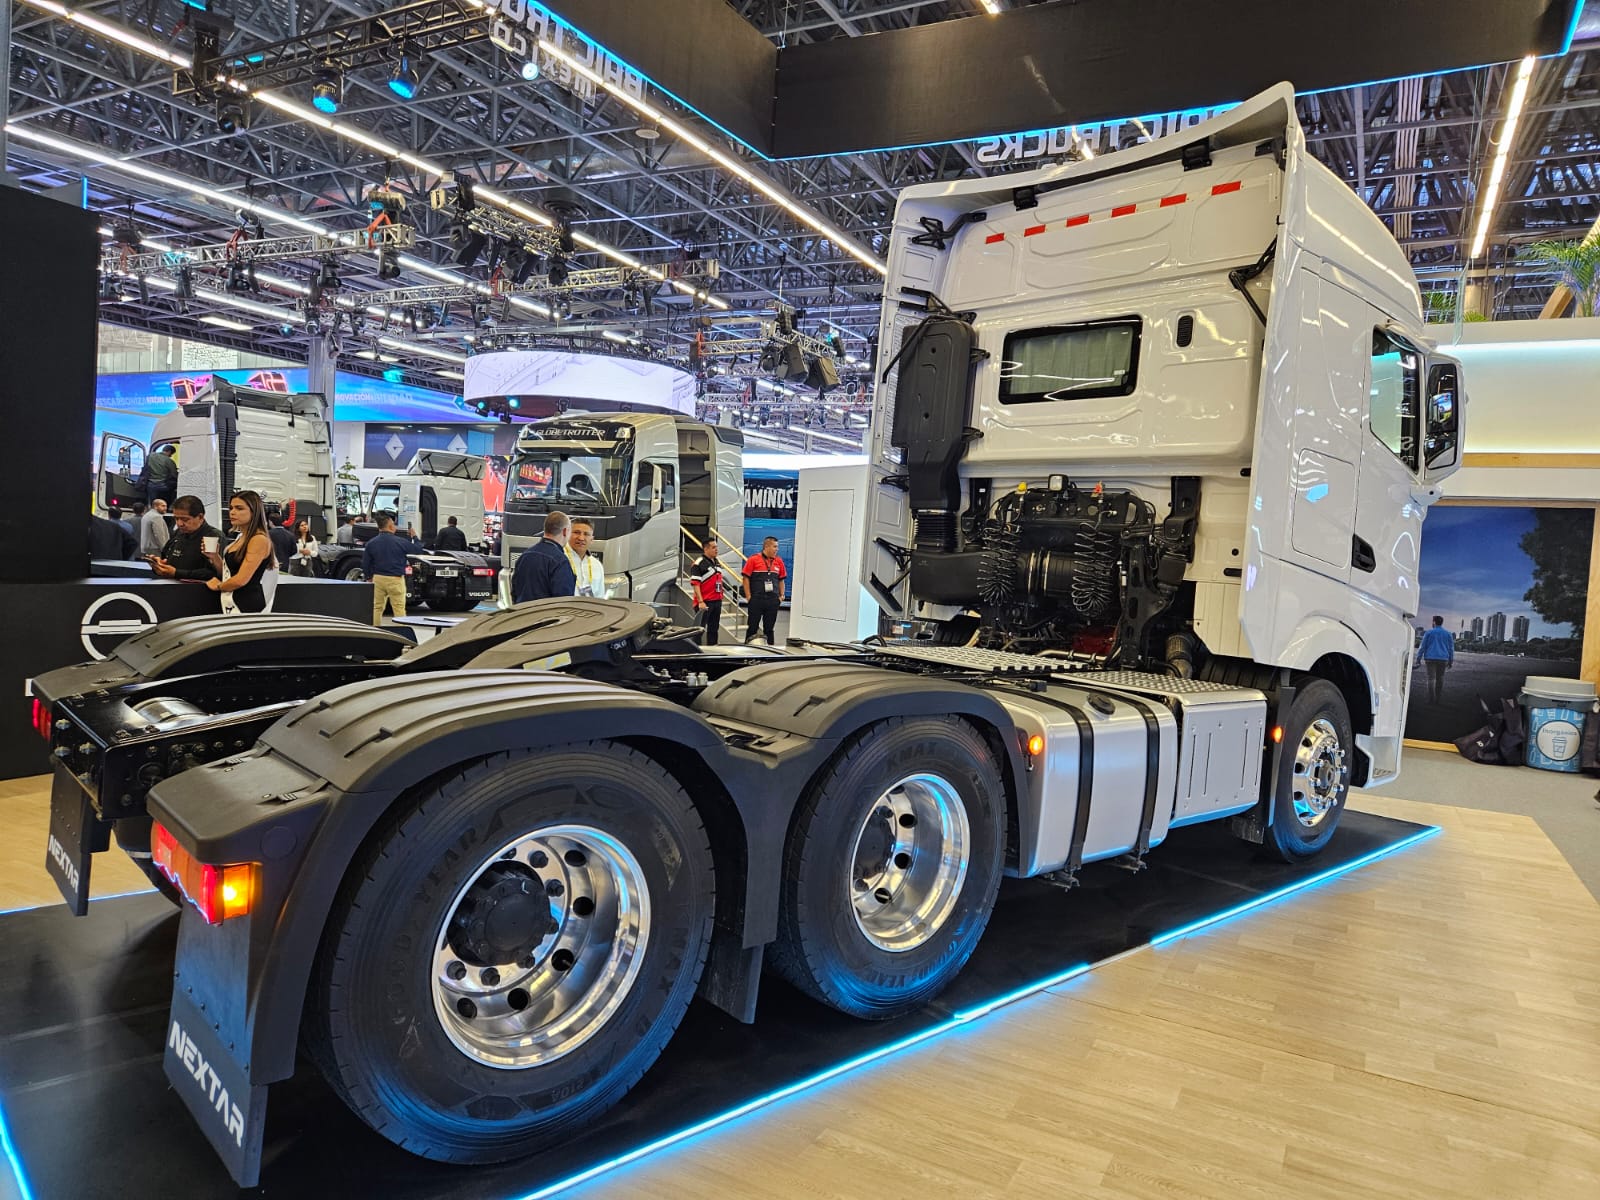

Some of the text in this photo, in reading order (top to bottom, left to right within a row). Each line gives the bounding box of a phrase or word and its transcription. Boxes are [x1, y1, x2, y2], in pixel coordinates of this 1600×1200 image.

[744, 487, 794, 509] AMINOS
[48, 834, 80, 894] NEXTAR
[168, 1020, 246, 1148] NEXTAR
